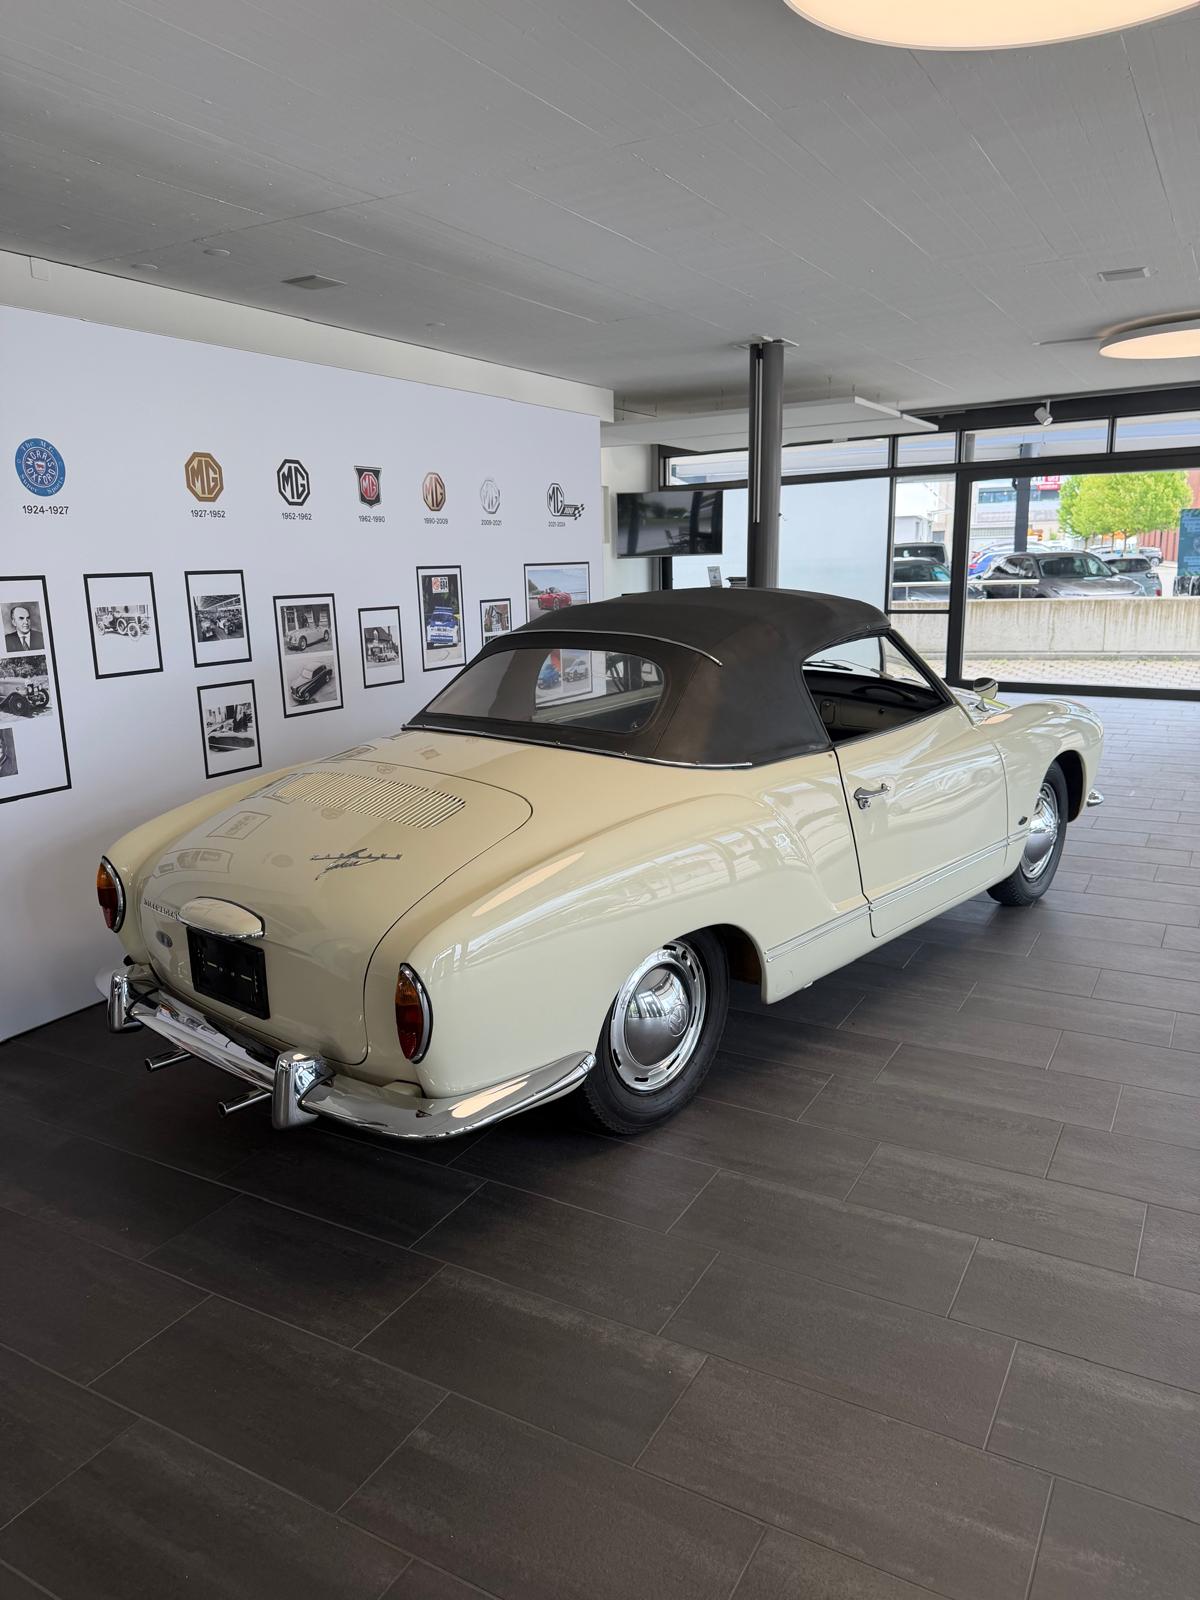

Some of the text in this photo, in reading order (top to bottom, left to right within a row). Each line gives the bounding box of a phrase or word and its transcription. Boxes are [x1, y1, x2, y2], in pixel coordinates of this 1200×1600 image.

[26, 450, 55, 467] MORRIS
[26, 468, 56, 485] OXFORD
[189, 457, 220, 498] MG
[281, 465, 307, 501] MG
[362, 473, 378, 499] MG
[424, 476, 444, 508] MG
[548, 485, 563, 514] MG
[22, 504, 69, 515] 1924-1927
[190, 509, 226, 519] 1927-1952
[281, 512, 313, 521] 1952-1962
[358, 515, 386, 523] 1962-1990
[423, 517, 449, 525] 1990-2009
